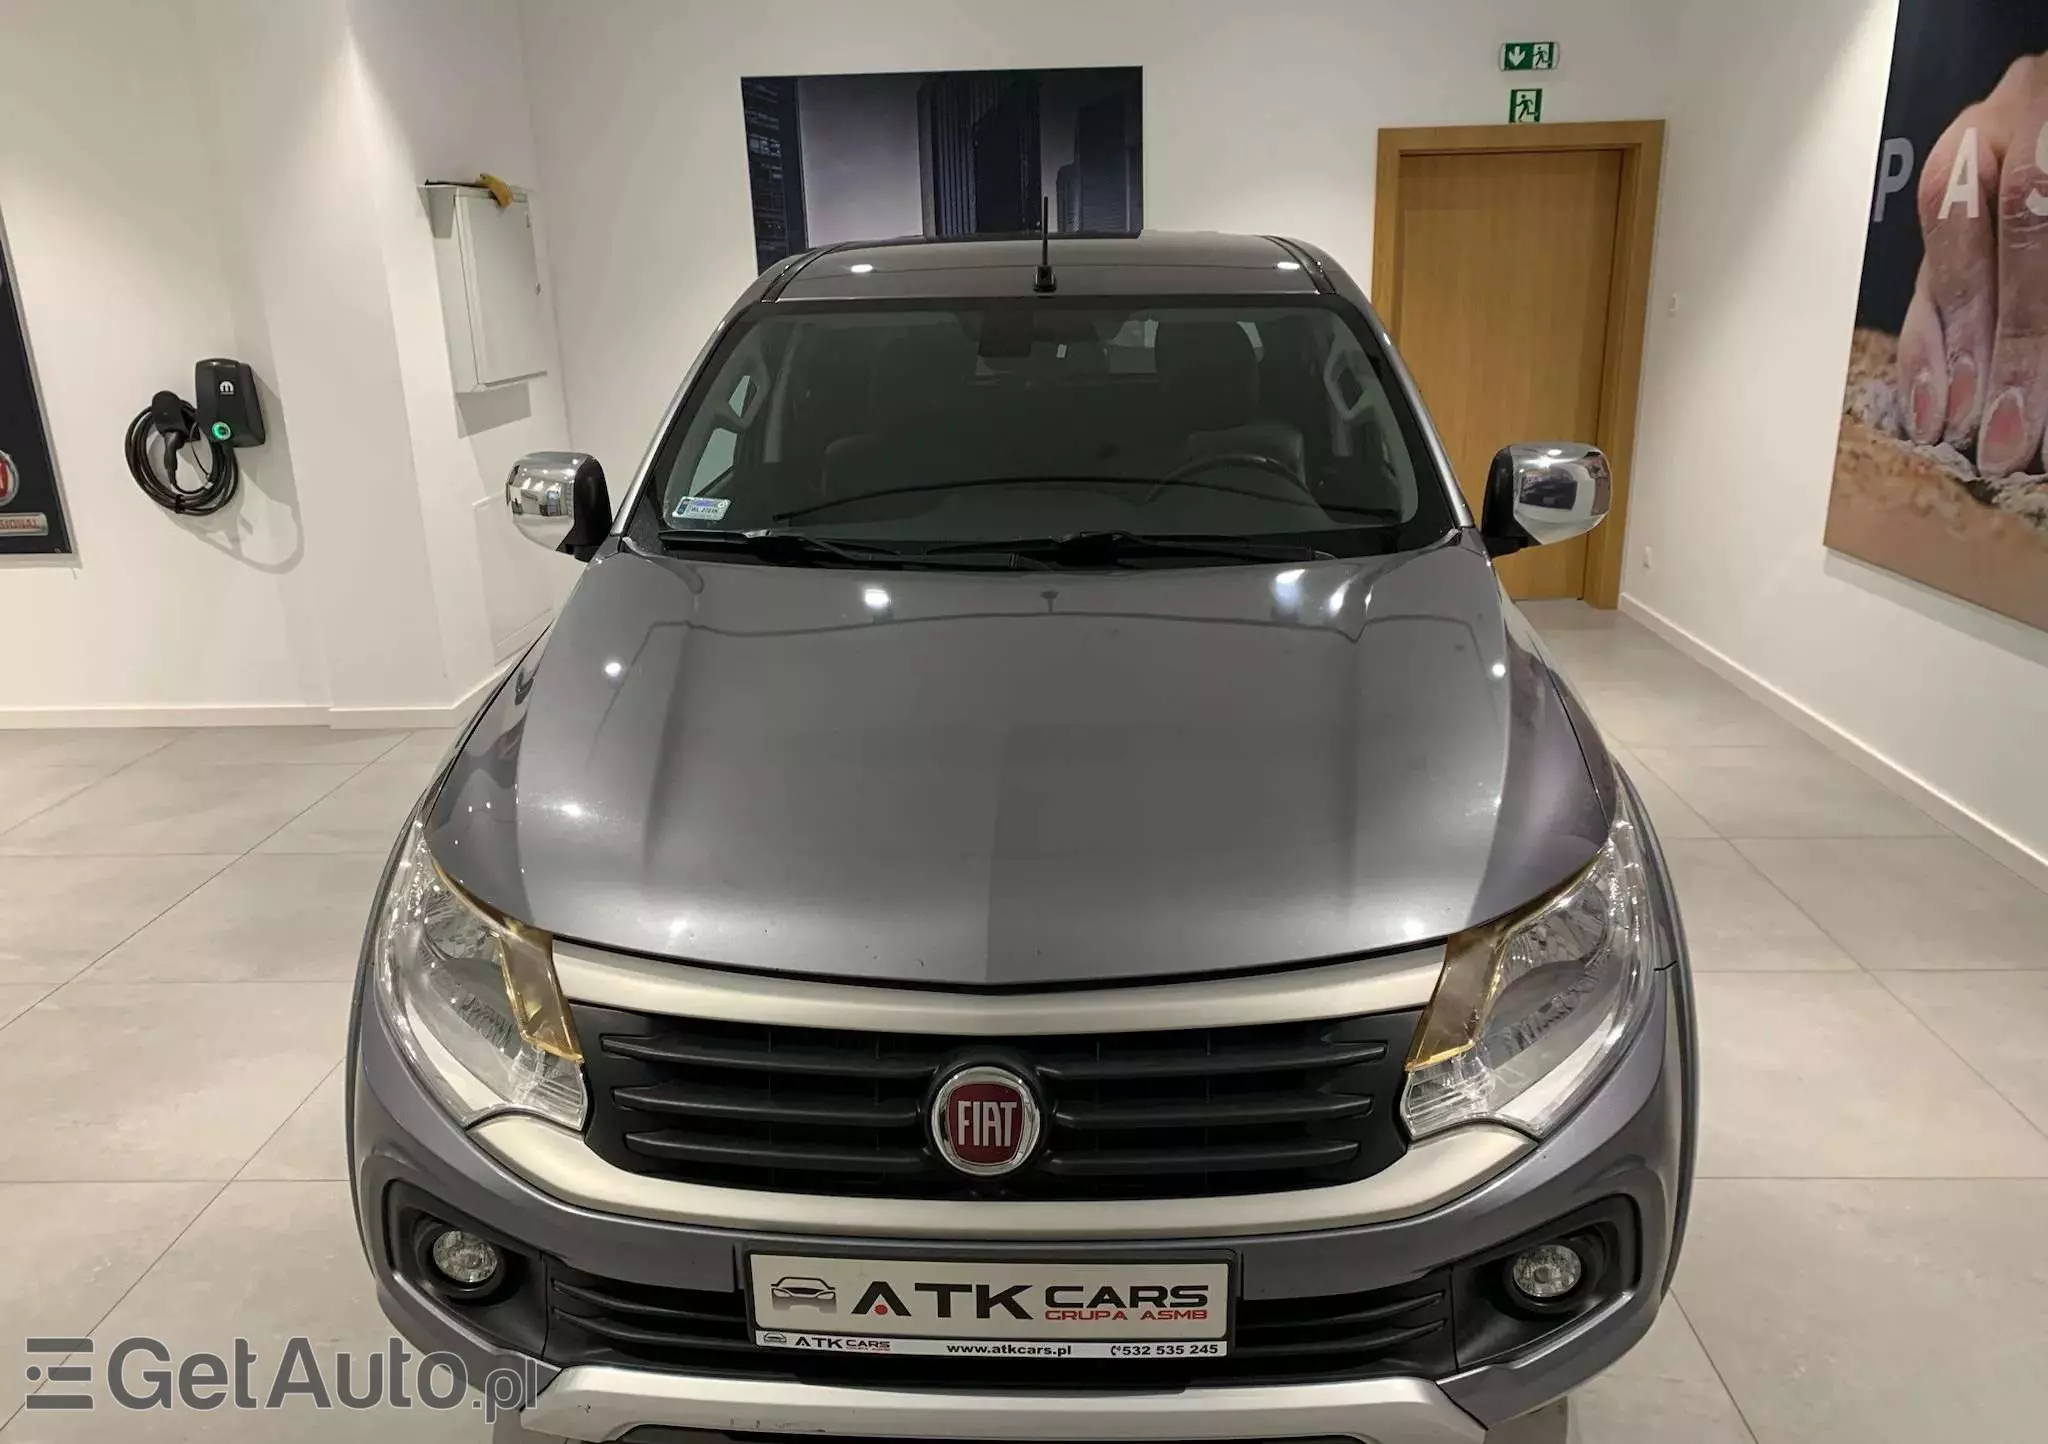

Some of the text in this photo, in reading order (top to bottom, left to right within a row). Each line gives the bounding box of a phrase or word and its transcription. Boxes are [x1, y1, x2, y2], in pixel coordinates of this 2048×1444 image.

[957, 1100, 1018, 1148] FIAT
[851, 1281, 1209, 1320] ATK CARS
[1045, 1309, 1208, 1321] GRUPA ASMB
[795, 1336, 890, 1349] ATK CARS
[947, 1344, 1072, 1357] www.atkcars.pl
[1122, 1344, 1218, 1356] 532 535 245
